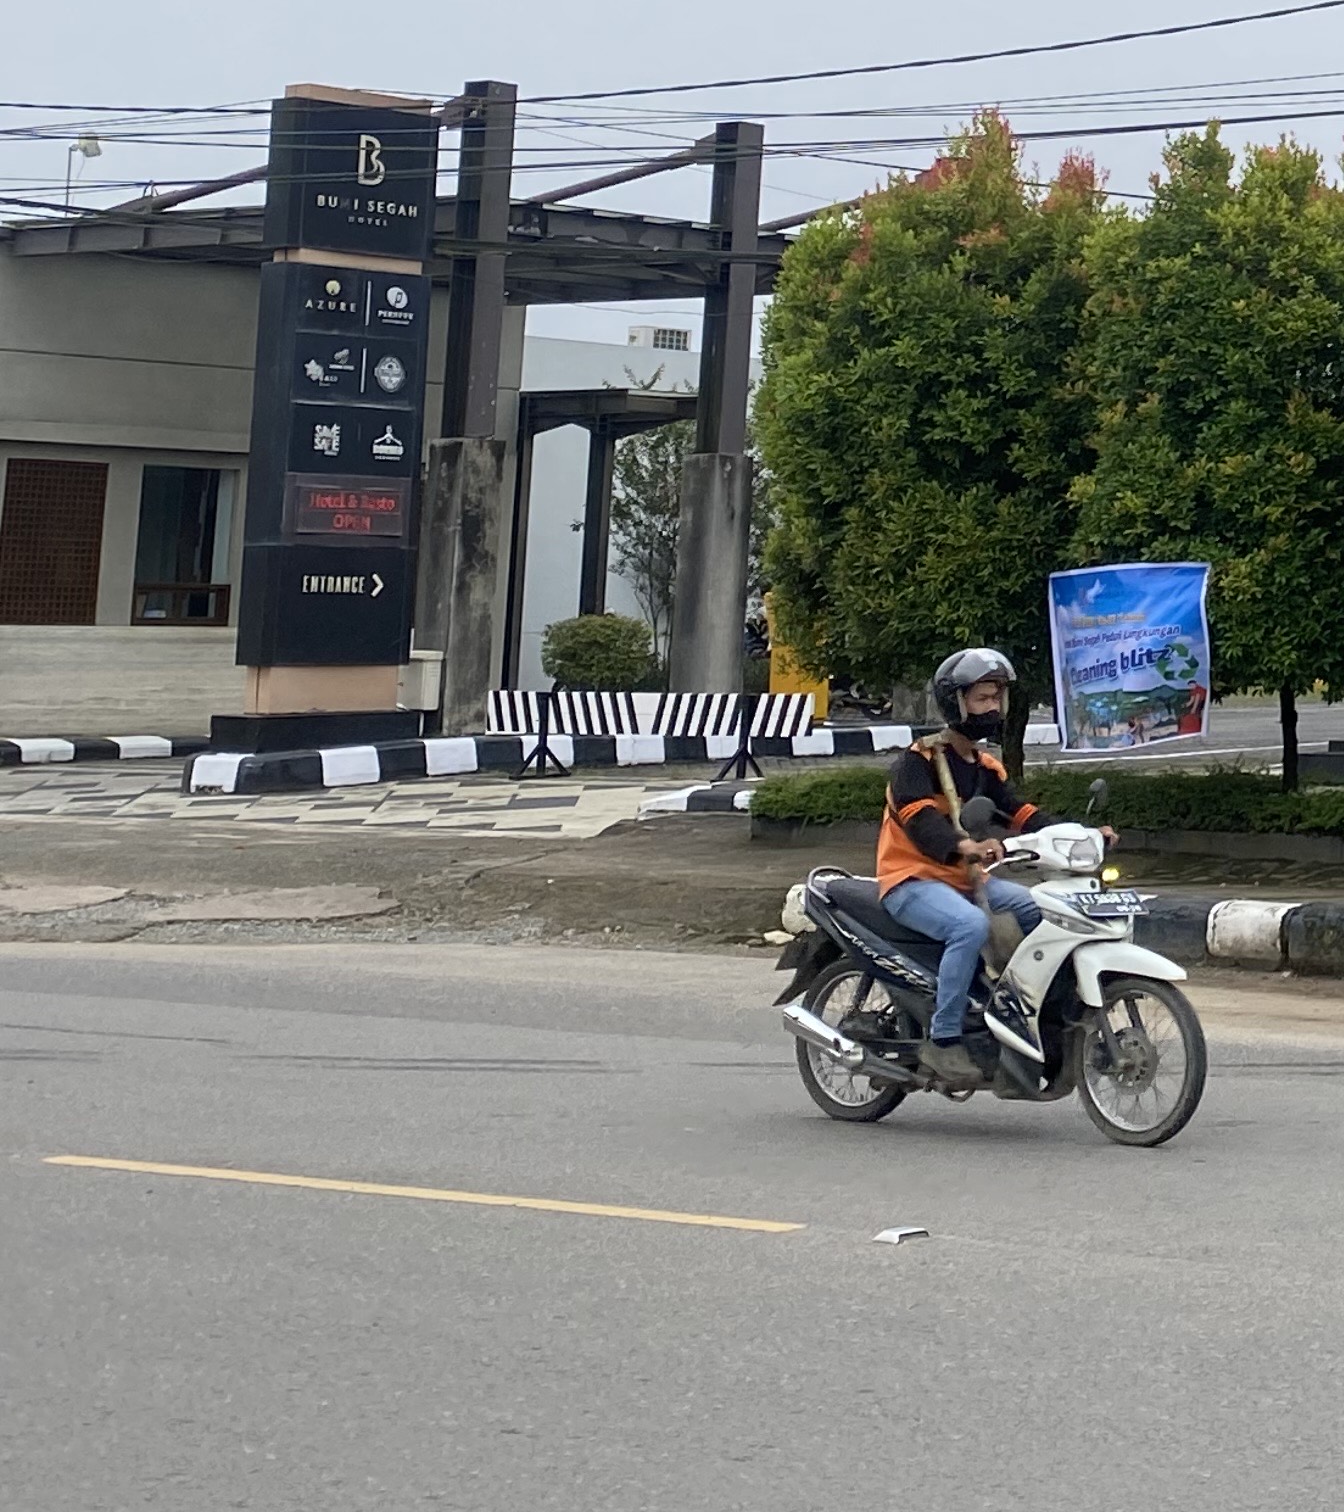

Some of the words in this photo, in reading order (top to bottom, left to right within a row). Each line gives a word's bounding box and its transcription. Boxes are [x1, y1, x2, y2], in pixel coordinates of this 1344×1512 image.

[358, 134, 385, 185] B
[317, 194, 359, 211] BUI
[367, 200, 418, 218] SEGAH
[304, 299, 357, 313] AZURE
[302, 575, 365, 594] ENTRANCE
